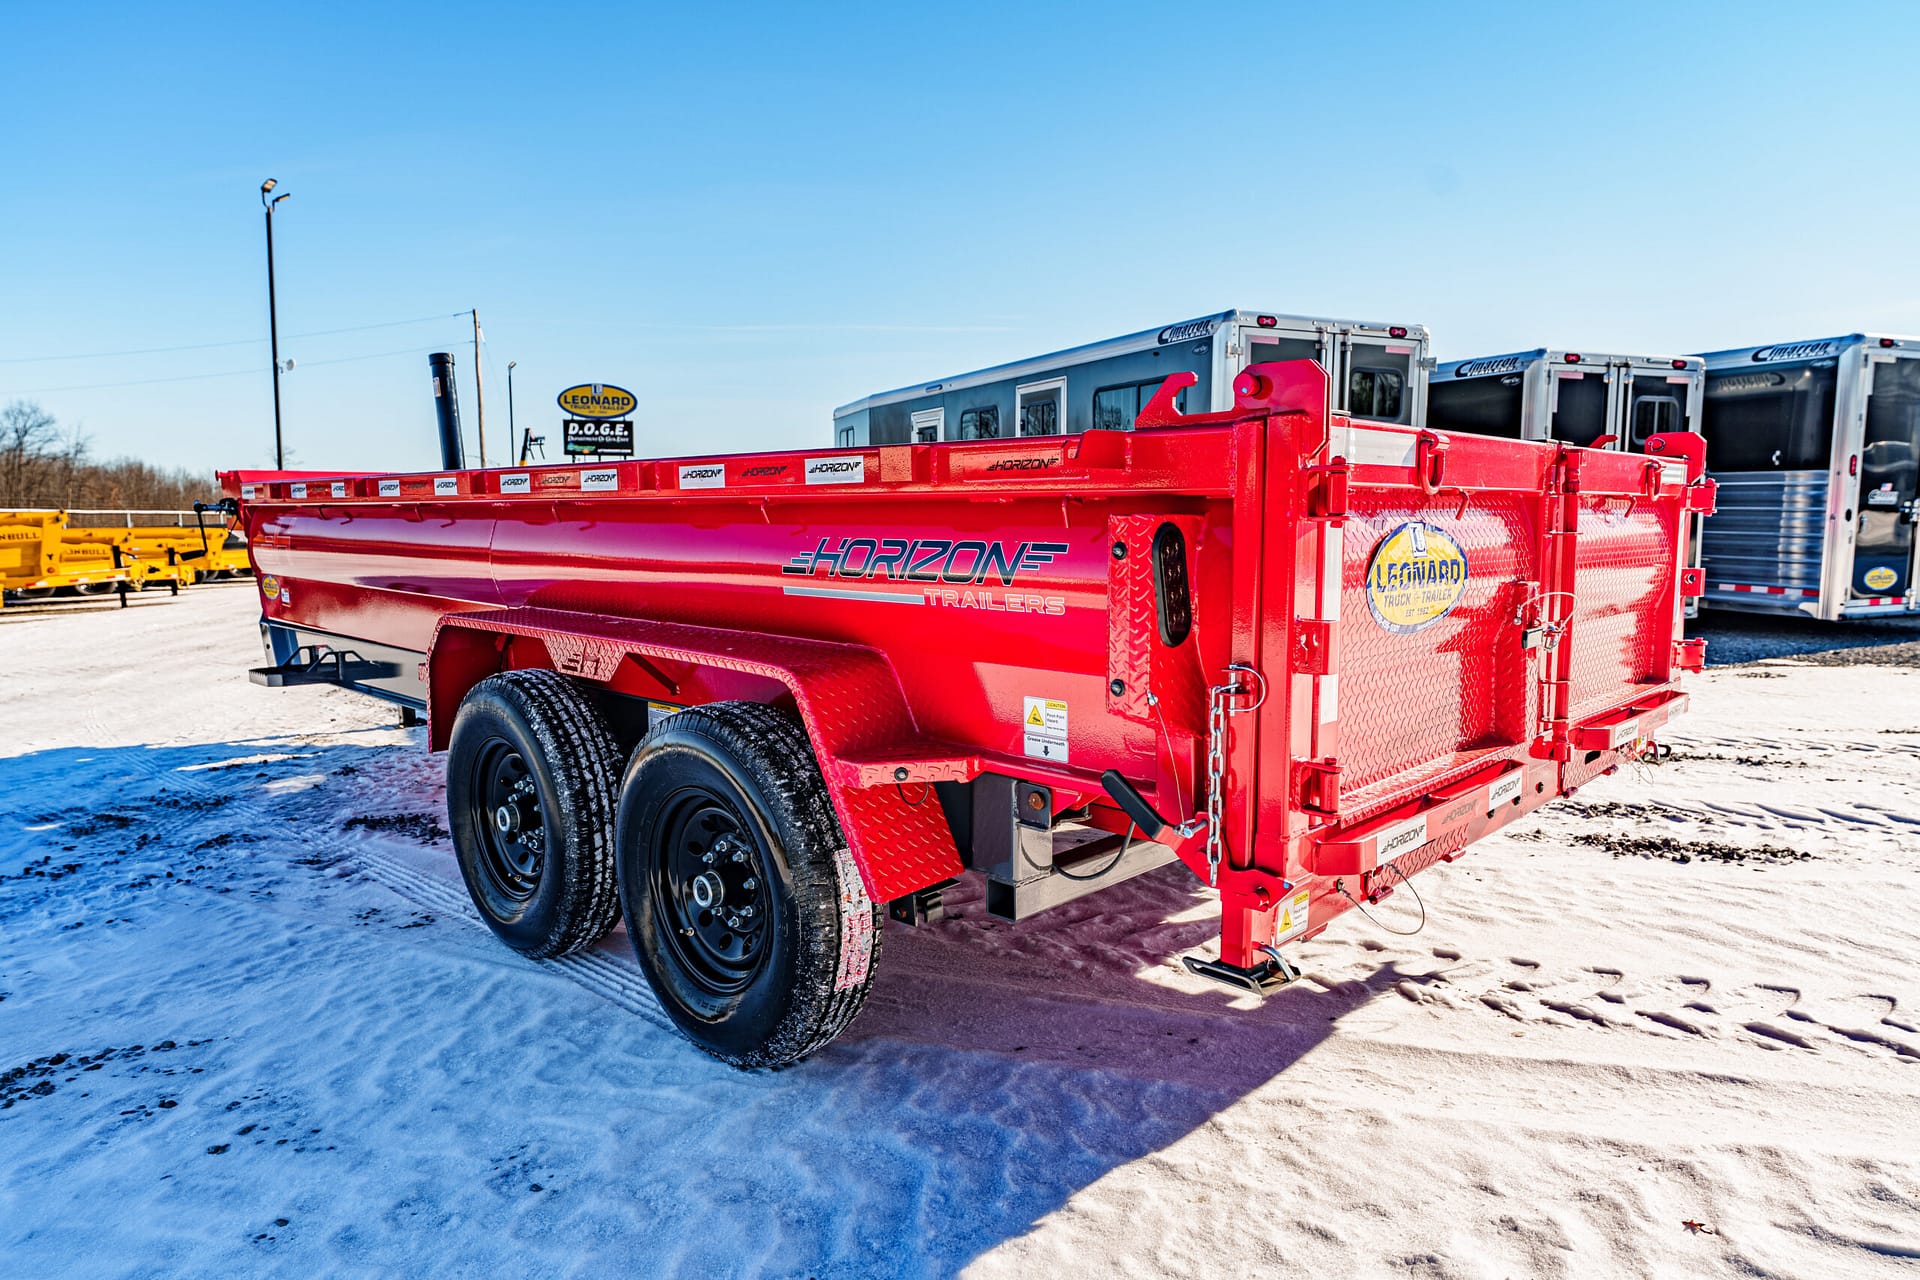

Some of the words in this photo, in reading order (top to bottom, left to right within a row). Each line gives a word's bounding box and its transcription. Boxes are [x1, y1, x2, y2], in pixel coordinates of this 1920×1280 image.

[1158, 319, 1211, 345] Cimarron
[1752, 341, 1832, 362] Cimarron
[1455, 357, 1519, 378] Cimarron
[564, 395, 630, 406] LEONARD
[568, 422, 629, 436] D.O.G.E.
[682, 468, 723, 479] HORIZON
[741, 465, 788, 477] HORIZON
[809, 461, 861, 473] HORIZON
[986, 458, 1059, 471] HORIZON
[502, 478, 528, 486] HORIZON
[584, 473, 616, 483] HORIZON
[782, 537, 1069, 587] HORIZON
[1376, 559, 1460, 592] LEONARD
[923, 588, 1066, 616] TRAILERS
[1384, 593, 1410, 608] TRUCK
[1422, 589, 1453, 604] TRAILER
[1491, 777, 1521, 801] HORIZON
[1381, 824, 1426, 854] HORIZON
